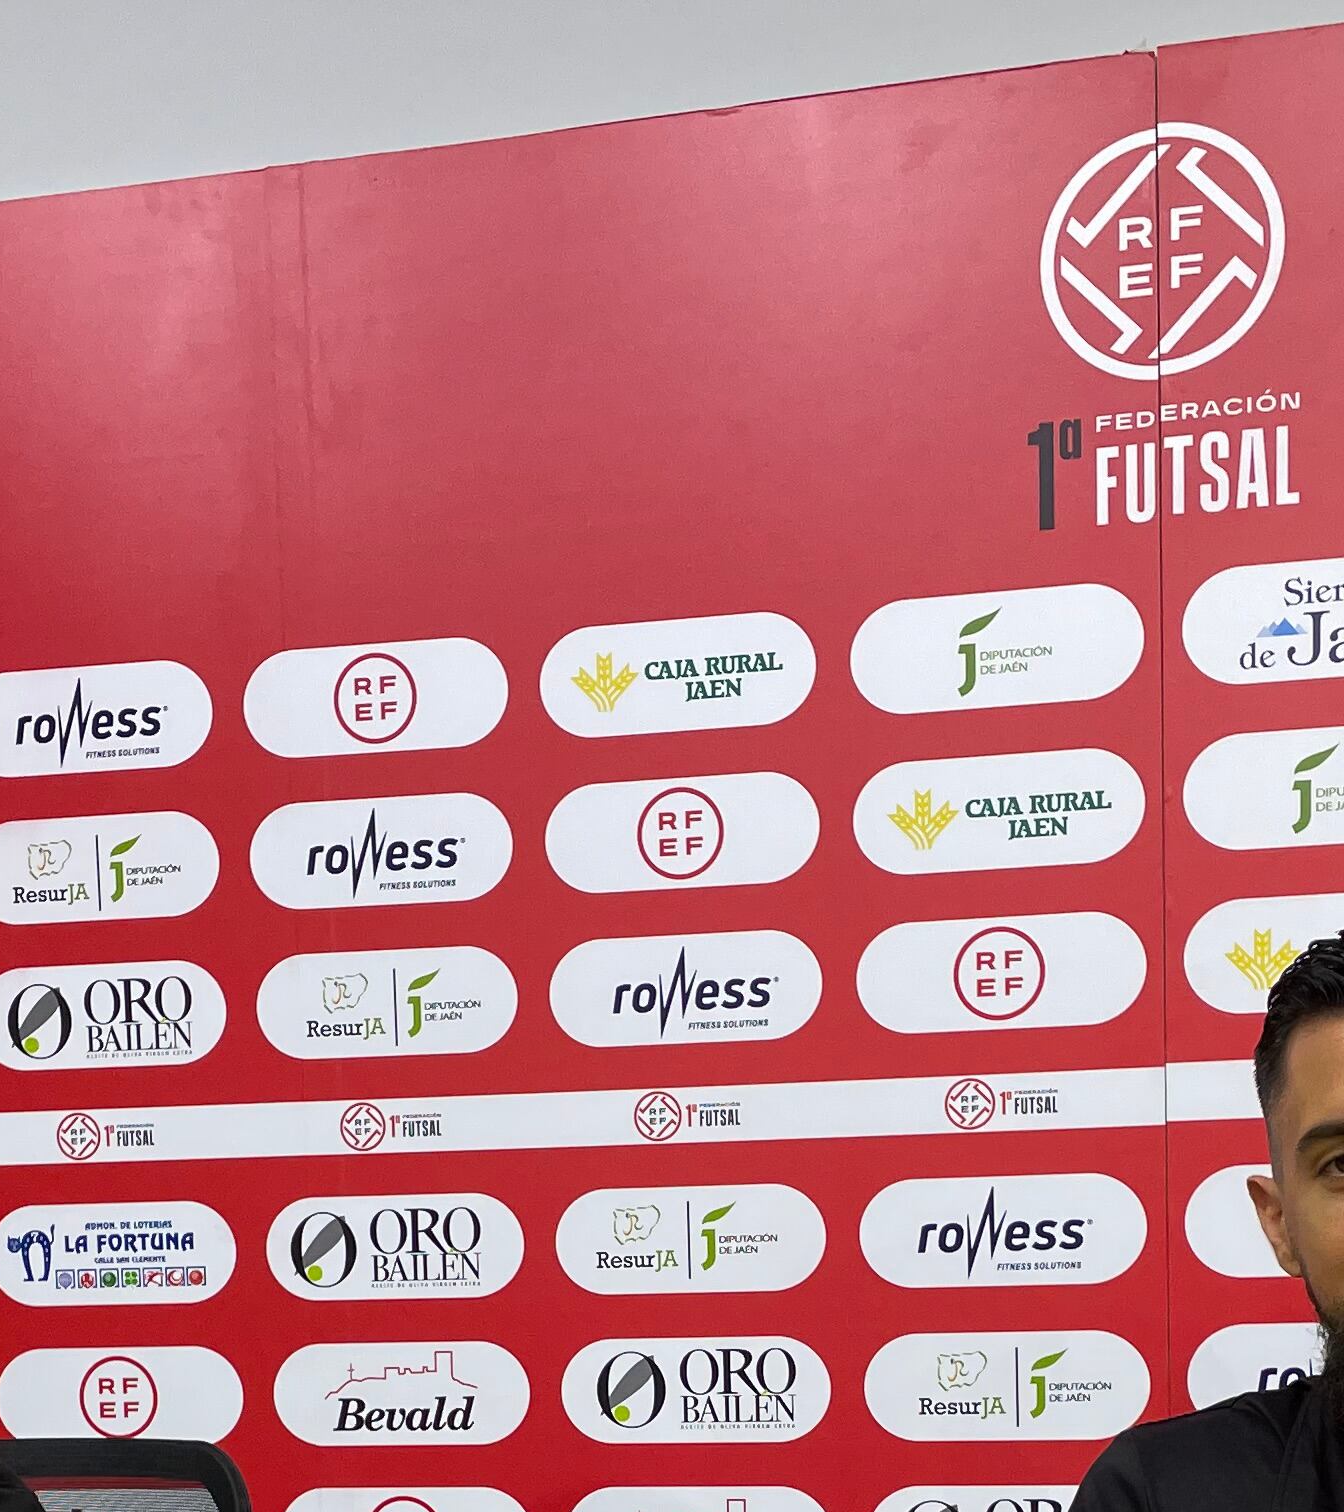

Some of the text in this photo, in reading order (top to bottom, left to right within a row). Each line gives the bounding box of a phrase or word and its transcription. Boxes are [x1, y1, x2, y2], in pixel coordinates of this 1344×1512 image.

[1096, 390, 1300, 432] FEDERACIÓN
[1096, 426, 1299, 526] FUTSAL
[645, 652, 783, 680] CAJA RURAL
[980, 646, 1052, 661] DIPUTACIÓN
[1240, 643, 1275, 669] de
[980, 661, 1027, 675] DE JAÉN
[685, 678, 741, 702] JAEN
[86, 747, 159, 758] FITNESS SOLUTIONS
[966, 791, 1112, 818] CAJA RURAL
[1316, 802, 1332, 812] DE
[1009, 817, 1068, 840] JAEN
[13, 884, 89, 905] ResurJA
[84, 976, 191, 1024] ORO
[87, 1018, 191, 1052] BAILÉN
[307, 1018, 385, 1040] ResurJA
[65, 1233, 194, 1254] LA FORTUNA
[370, 1207, 480, 1254] ORO
[372, 1247, 480, 1281] BAILÉN
[596, 1251, 678, 1272] ResurJA
[680, 1348, 796, 1395] ORO
[333, 1396, 474, 1431] Bevald
[682, 1390, 794, 1423] BAILÉN
[919, 1397, 1006, 1419] ResurJA
